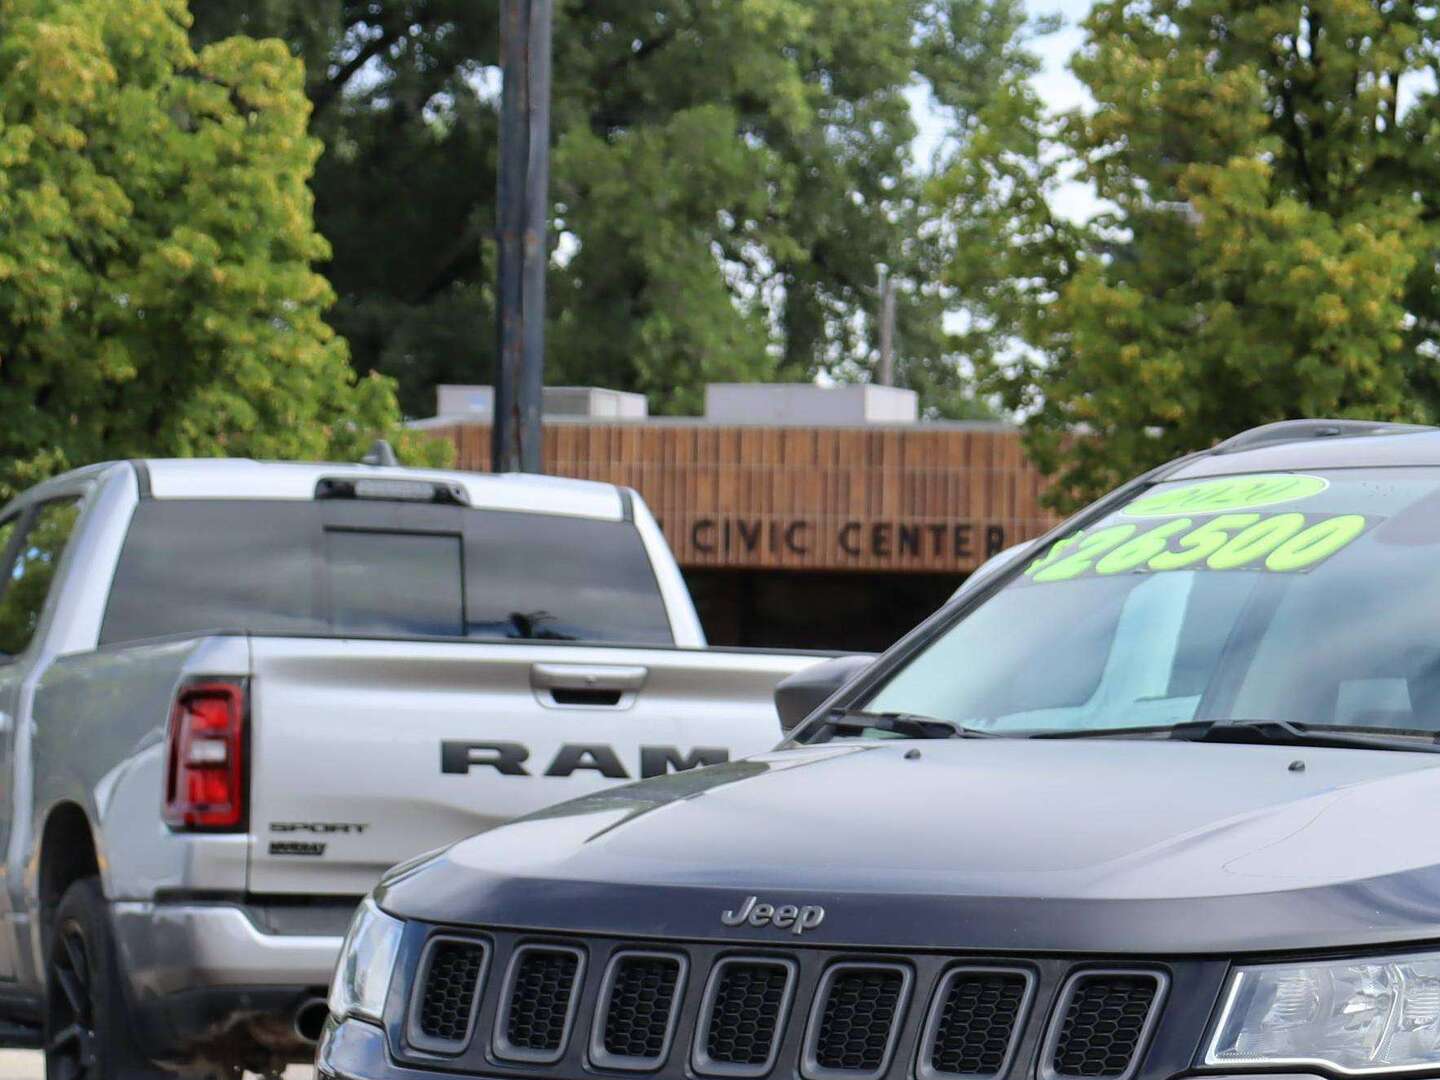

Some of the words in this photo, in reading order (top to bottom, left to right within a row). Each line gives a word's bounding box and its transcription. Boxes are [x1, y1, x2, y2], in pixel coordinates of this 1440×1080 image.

[691, 518, 808, 556] CIVIC
[838, 521, 1005, 559] CENTER
[440, 739, 730, 780] RAM
[269, 822, 371, 834] SPORT
[720, 895, 825, 935] Jeep
